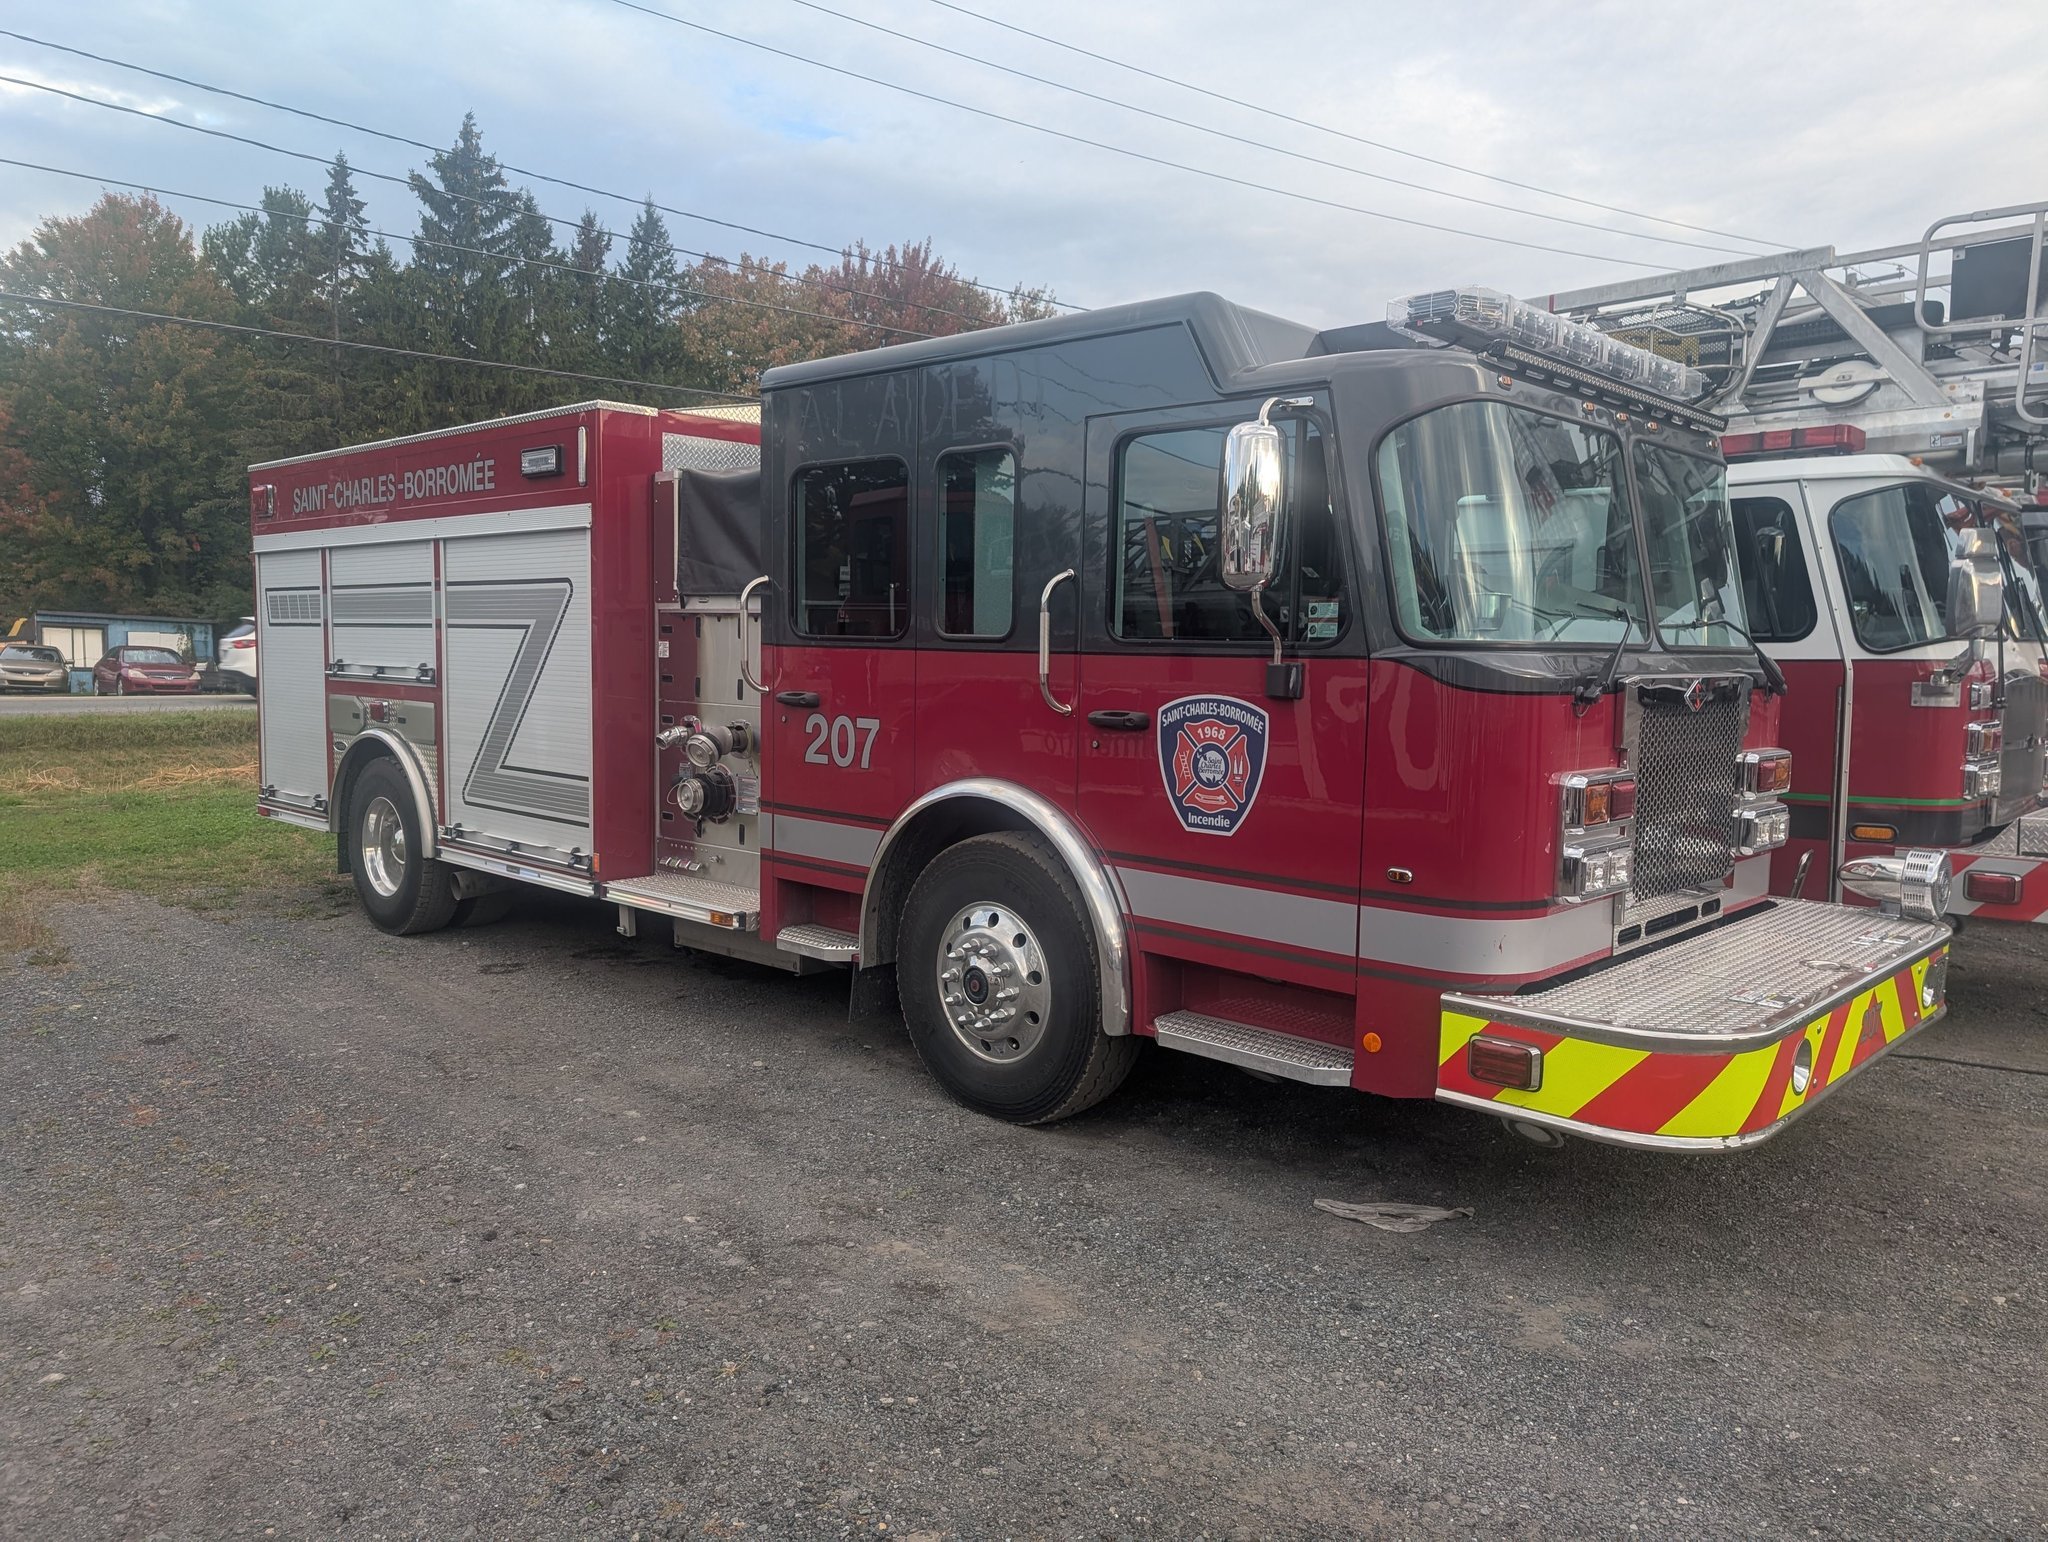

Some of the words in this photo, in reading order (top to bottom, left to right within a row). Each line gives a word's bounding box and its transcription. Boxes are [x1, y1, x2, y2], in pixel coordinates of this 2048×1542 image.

[293, 452, 495, 513] SAINT-CHARLES-BORROMÉE
[1162, 702, 1264, 734] SAINT-CHARLES-BORROMÉE
[1197, 726, 1225, 740] 1968
[804, 713, 880, 769] 207
[1188, 812, 1230, 827] Incendie
